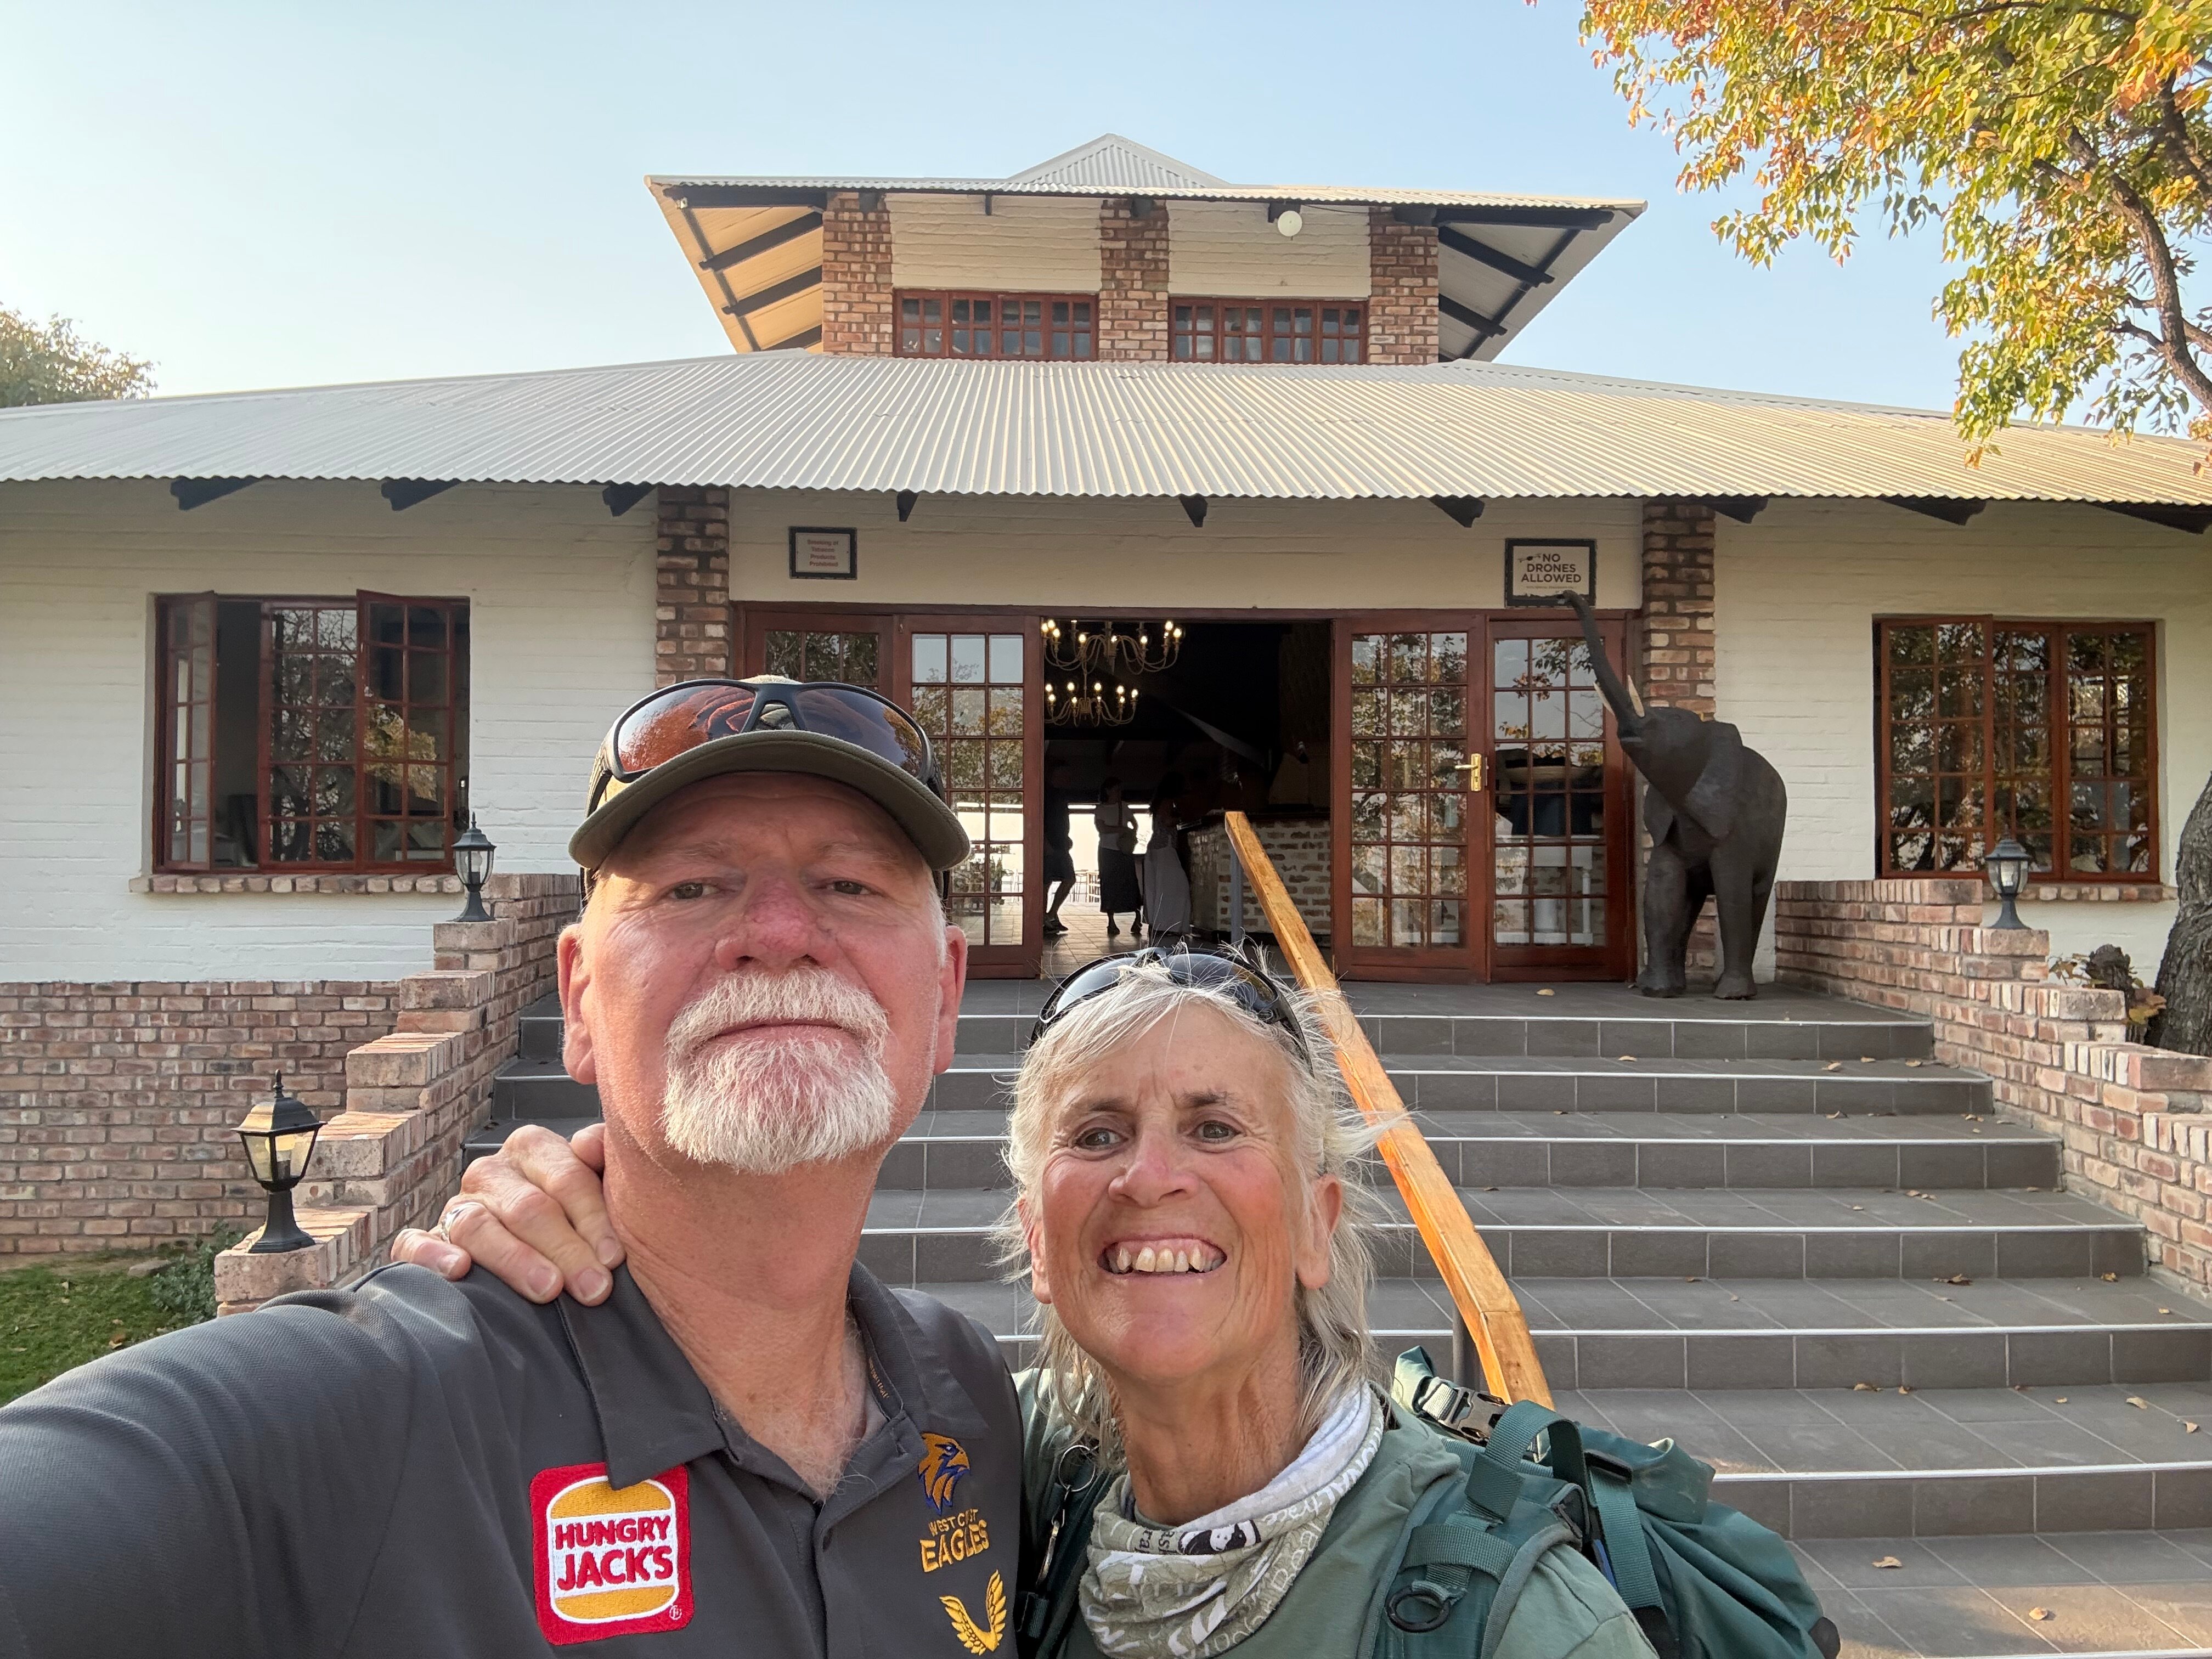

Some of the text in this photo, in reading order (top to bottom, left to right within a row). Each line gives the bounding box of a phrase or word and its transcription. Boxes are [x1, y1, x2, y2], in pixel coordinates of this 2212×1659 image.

[1527, 563, 1576, 573] DRONES
[1543, 554, 1560, 562] NO
[1521, 574, 1581, 583] ALLOWED
[555, 1515, 670, 1550] HUNGRY
[928, 1516, 956, 1537] WEST
[919, 1519, 989, 1572] EAGLES
[557, 1545, 673, 1591] JACK'S
